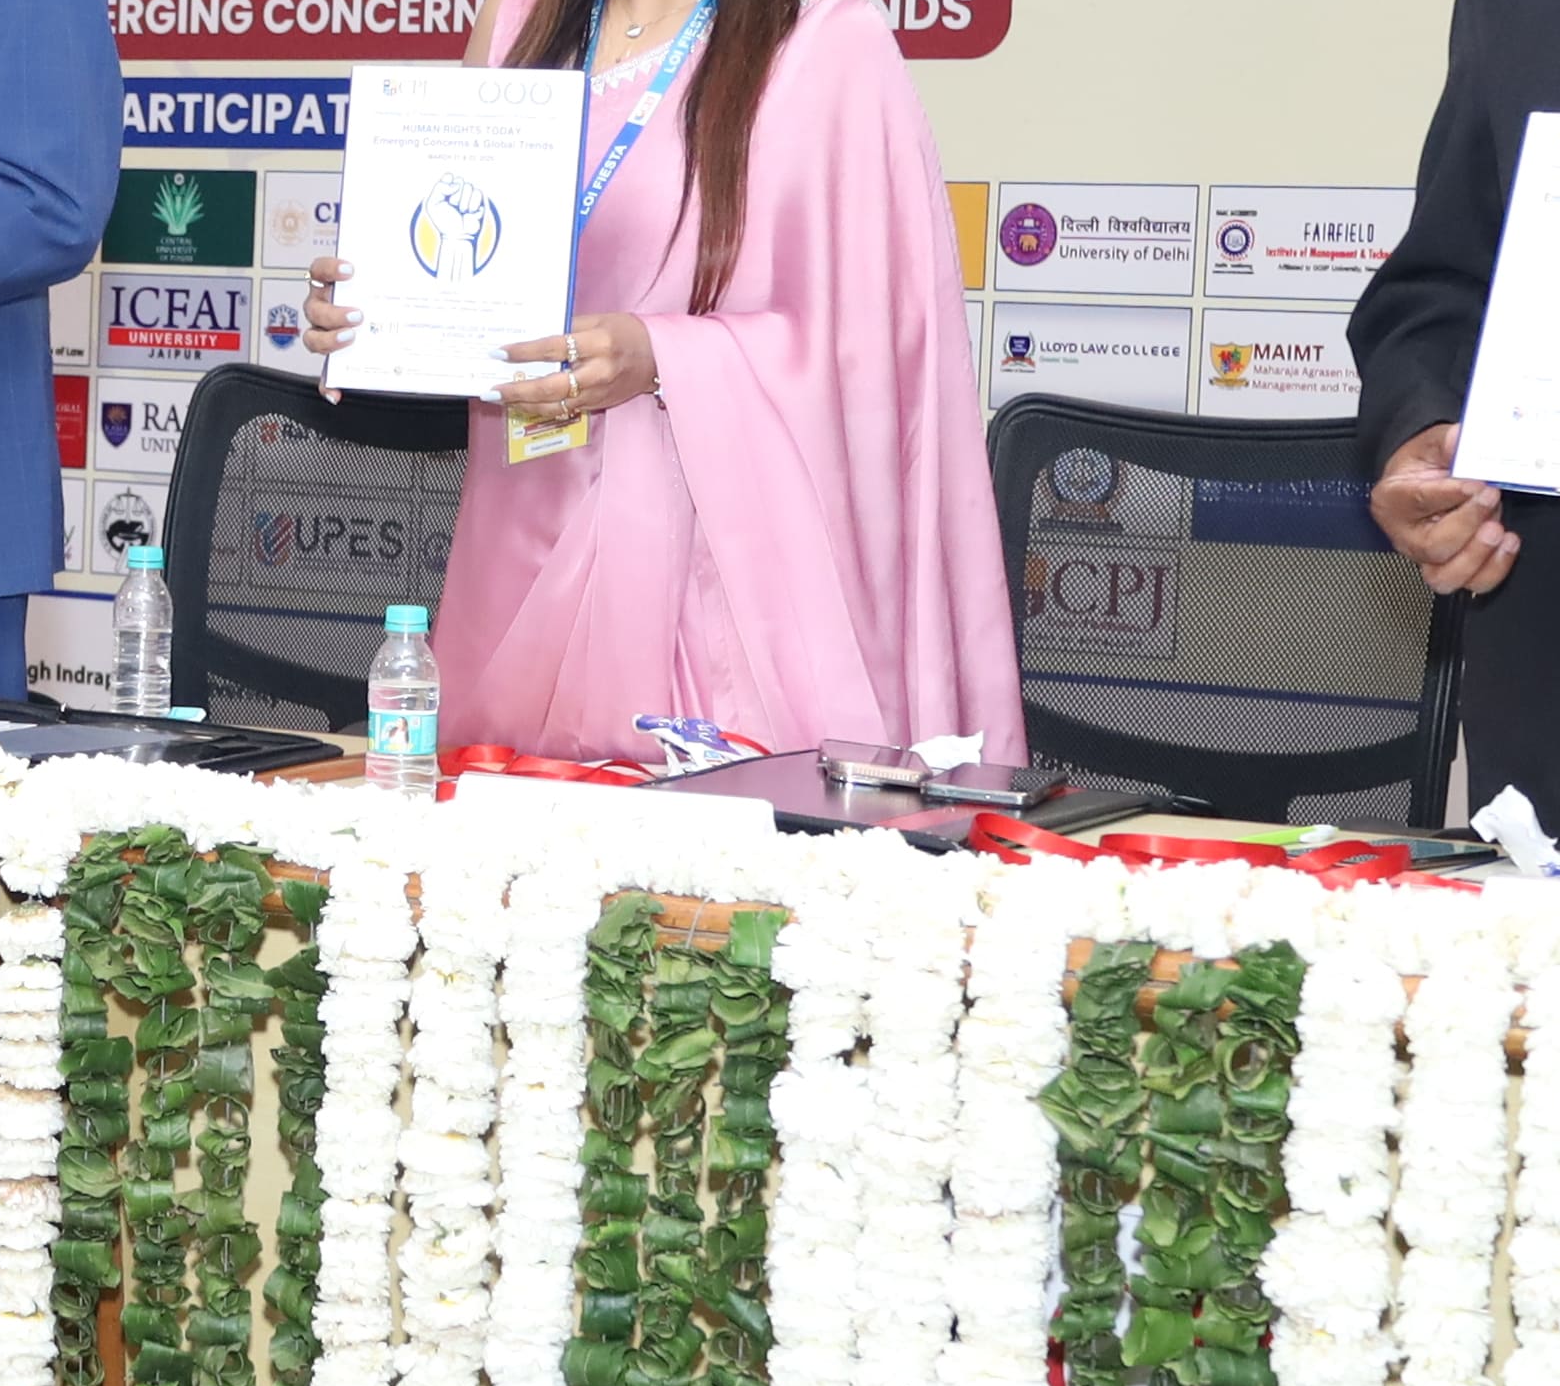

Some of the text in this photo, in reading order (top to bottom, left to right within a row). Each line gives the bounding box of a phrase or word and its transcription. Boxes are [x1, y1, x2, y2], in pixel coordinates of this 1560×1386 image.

[663, 5, 713, 75] LOI FIESTA
[122, 92, 350, 135] ARTICIPAT
[580, 143, 628, 216] LOI FIESTA
[1060, 214, 1191, 235] दिल्ली विश्वविद्यालय
[1303, 221, 1376, 244] FAIRFIELD
[1059, 244, 1191, 264] University of Delhi
[1265, 246, 1298, 258] Institute
[1309, 247, 1358, 262] Management
[109, 286, 242, 332] ICFAI
[127, 331, 219, 348] UNIVERSITY
[1039, 340, 1182, 358] LLOYD LAW COLLEGE
[147, 348, 202, 360] JAIPUR
[1253, 343, 1325, 363] MAIMT
[1253, 364, 1300, 377] Maharaja
[1301, 366, 1343, 380] Agrasen
[1251, 379, 1318, 393] Management
[1319, 381, 1339, 393] and
[295, 514, 405, 561] UPES
[1050, 559, 1170, 635] CPJ
